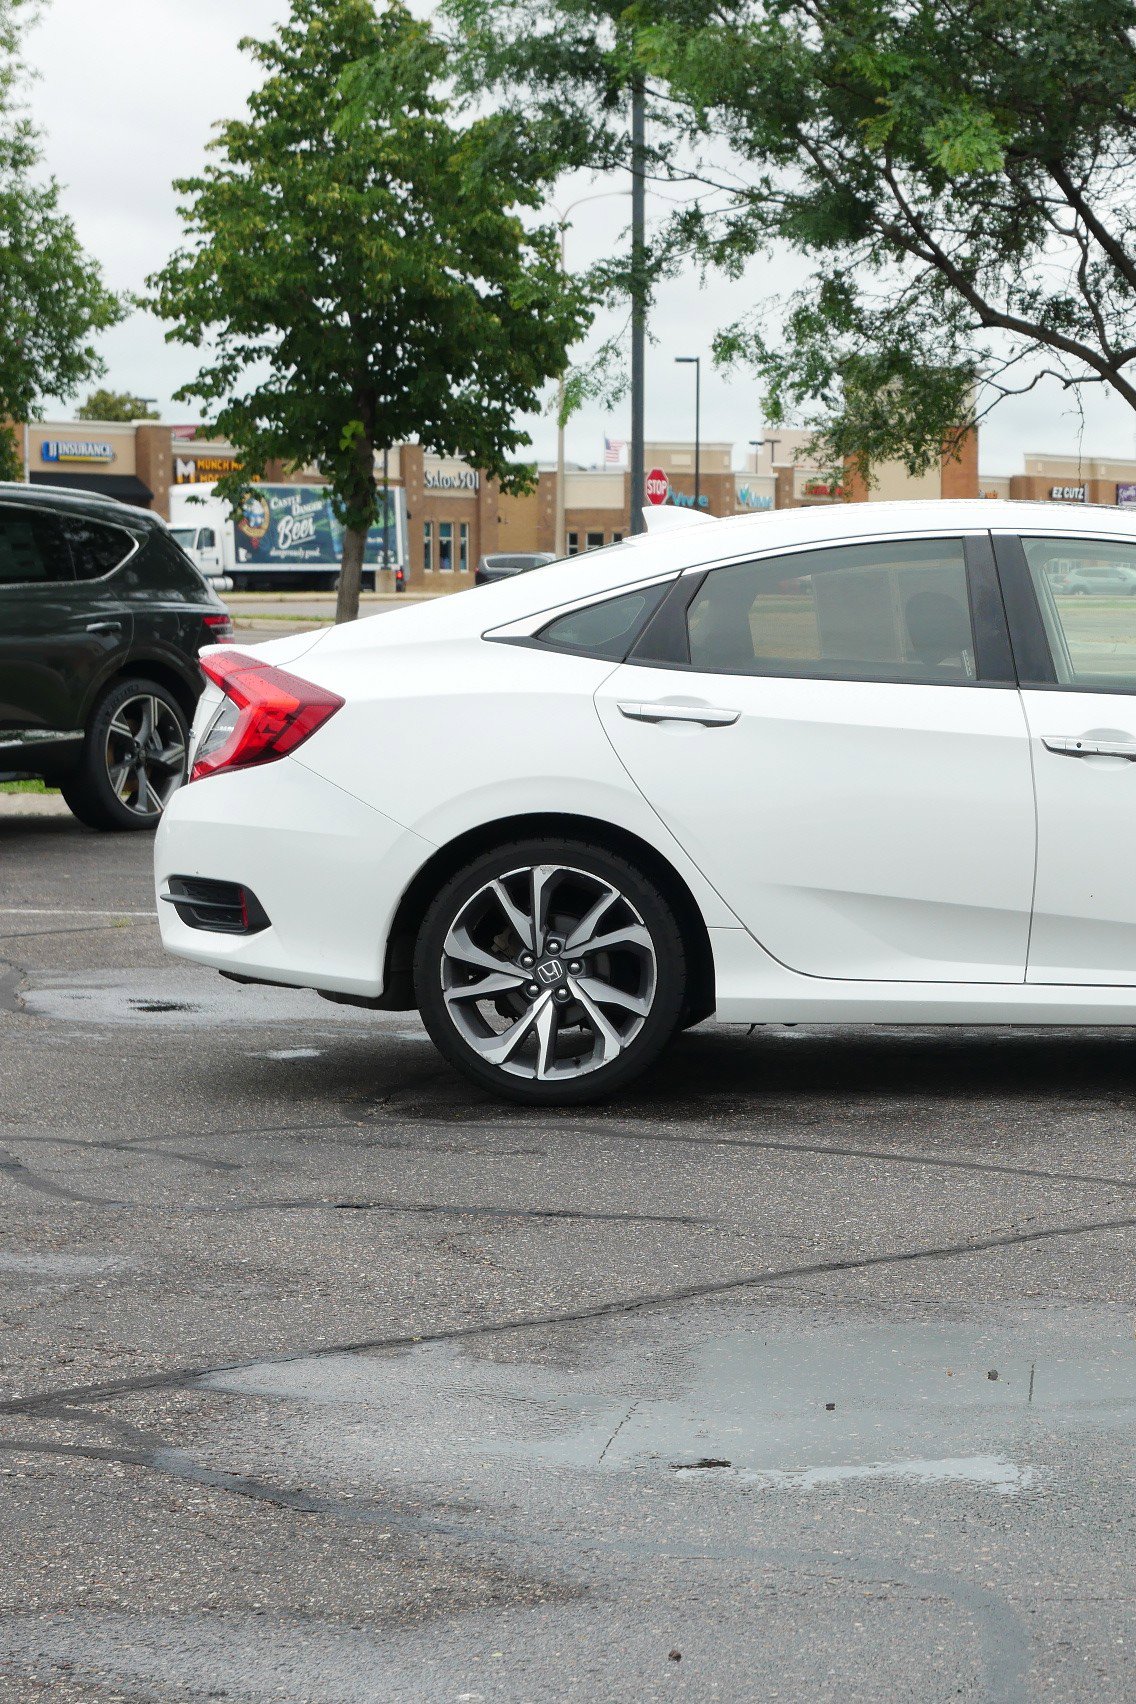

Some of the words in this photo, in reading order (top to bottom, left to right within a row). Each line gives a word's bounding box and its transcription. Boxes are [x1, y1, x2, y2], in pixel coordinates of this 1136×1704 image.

[59, 442, 113, 456] INSURANCE
[197, 459, 230, 470] MUNCH
[647, 479, 668, 495] STOP
[1052, 486, 1063, 499] EZ
[1063, 487, 1084, 499] CUTZ
[277, 515, 315, 549] Beer
